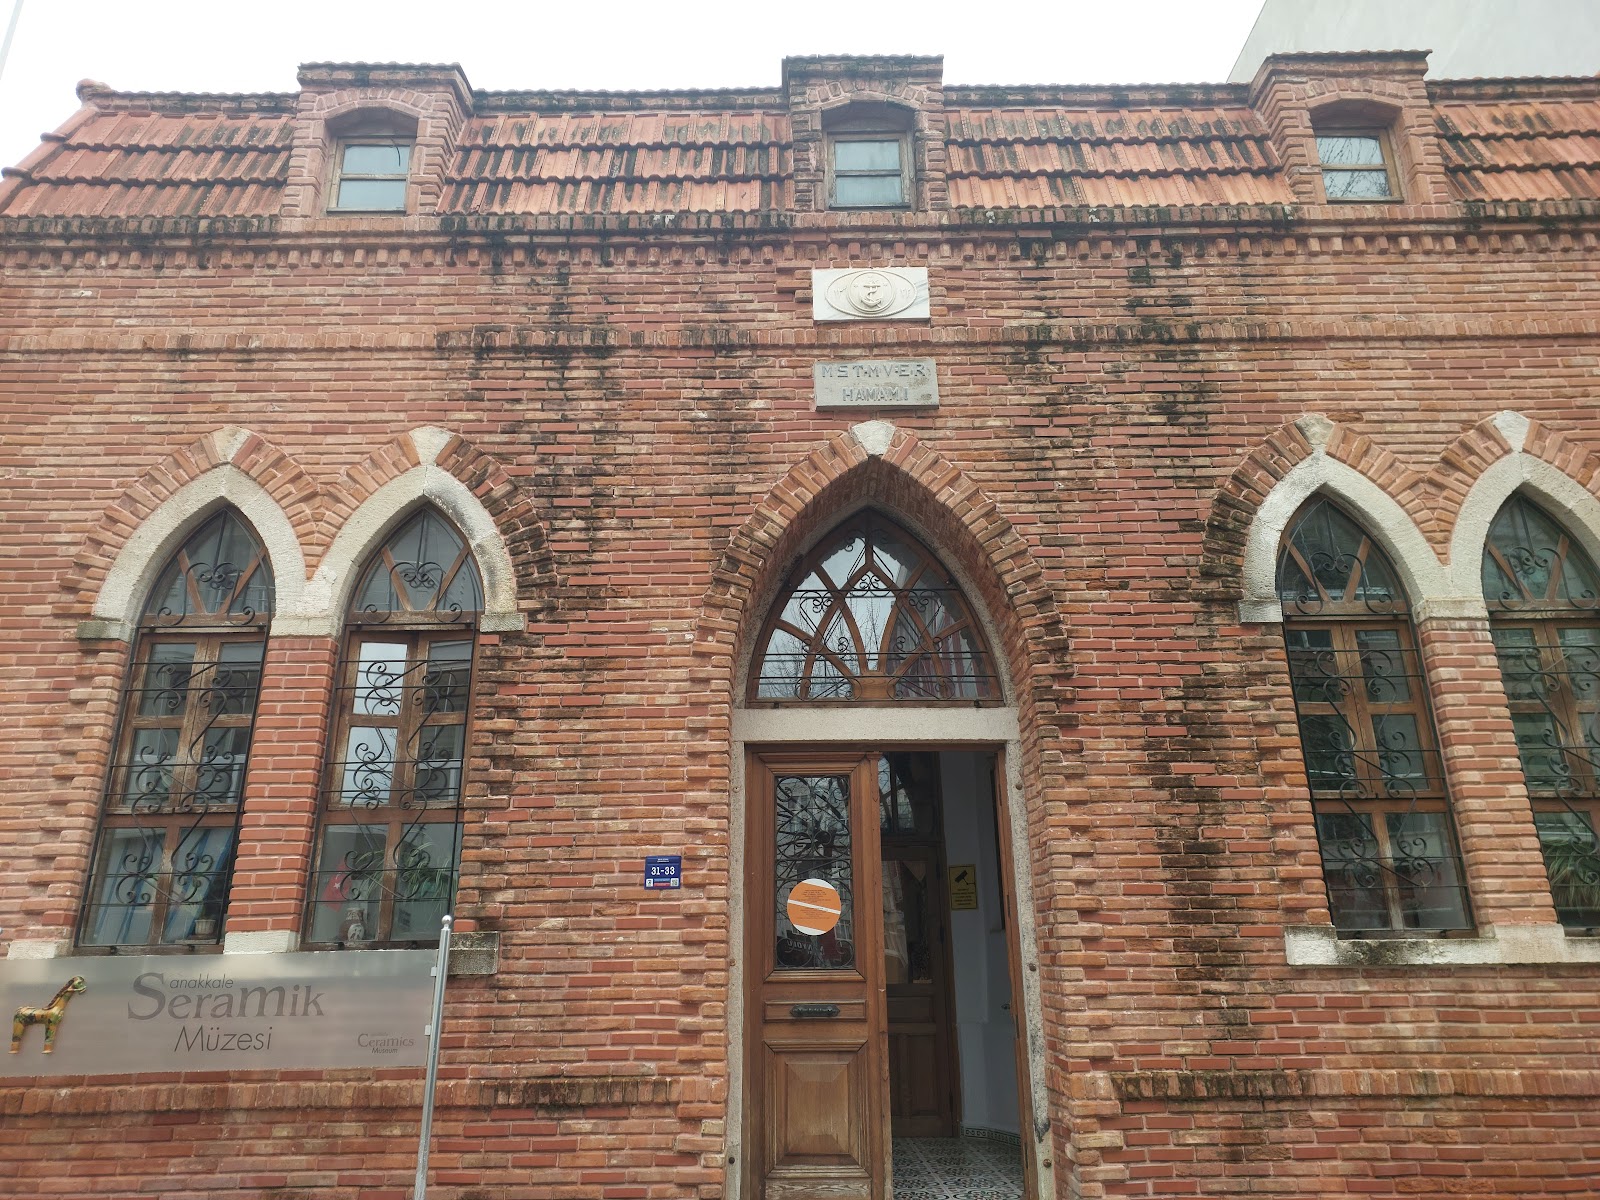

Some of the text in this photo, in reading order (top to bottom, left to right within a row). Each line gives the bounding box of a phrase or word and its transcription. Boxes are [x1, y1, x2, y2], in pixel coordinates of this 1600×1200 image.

[651, 866, 675, 876] 31-33
[169, 973, 234, 989] anakkale
[128, 972, 325, 1021] Seramik
[174, 1025, 273, 1053] Müzesi
[357, 1033, 414, 1048] Ceramics
